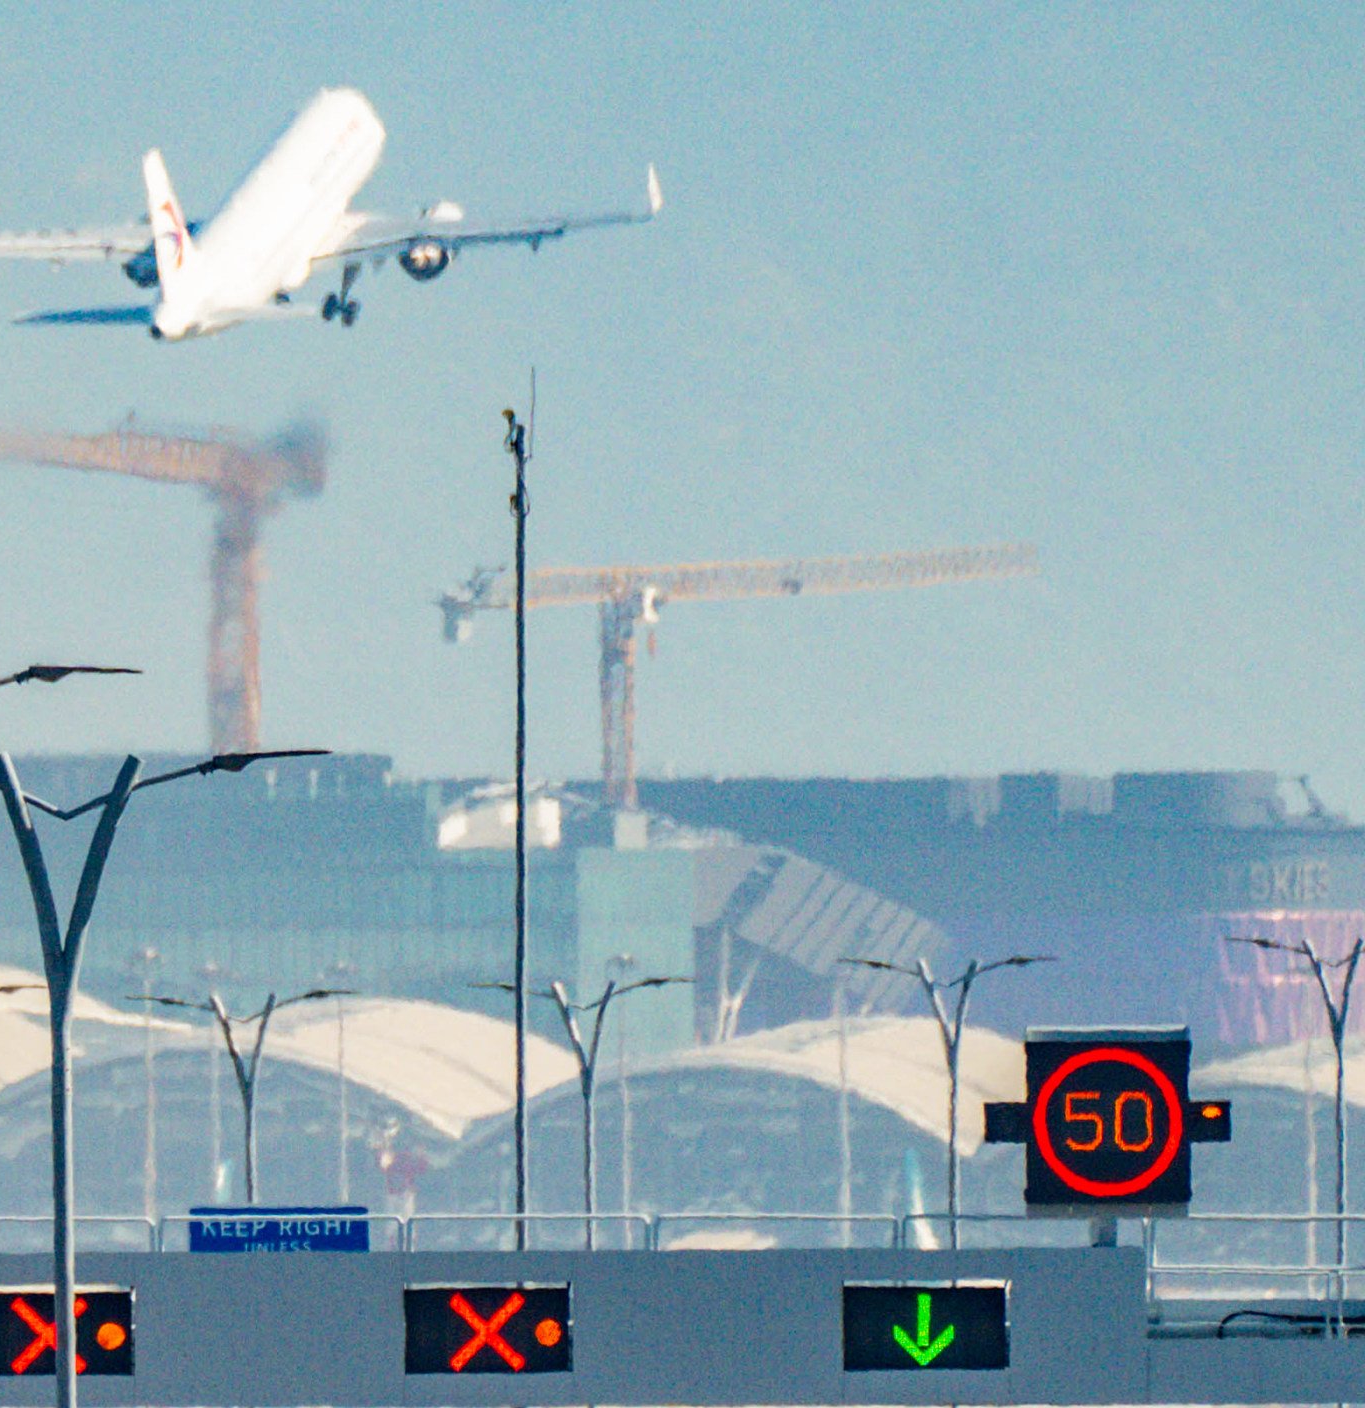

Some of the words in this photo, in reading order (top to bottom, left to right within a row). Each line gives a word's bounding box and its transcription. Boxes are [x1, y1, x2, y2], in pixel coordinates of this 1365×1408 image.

[1064, 1091, 1154, 1152] 50
[201, 1219, 267, 1237] KEEP
[279, 1219, 352, 1236] RIGHT
